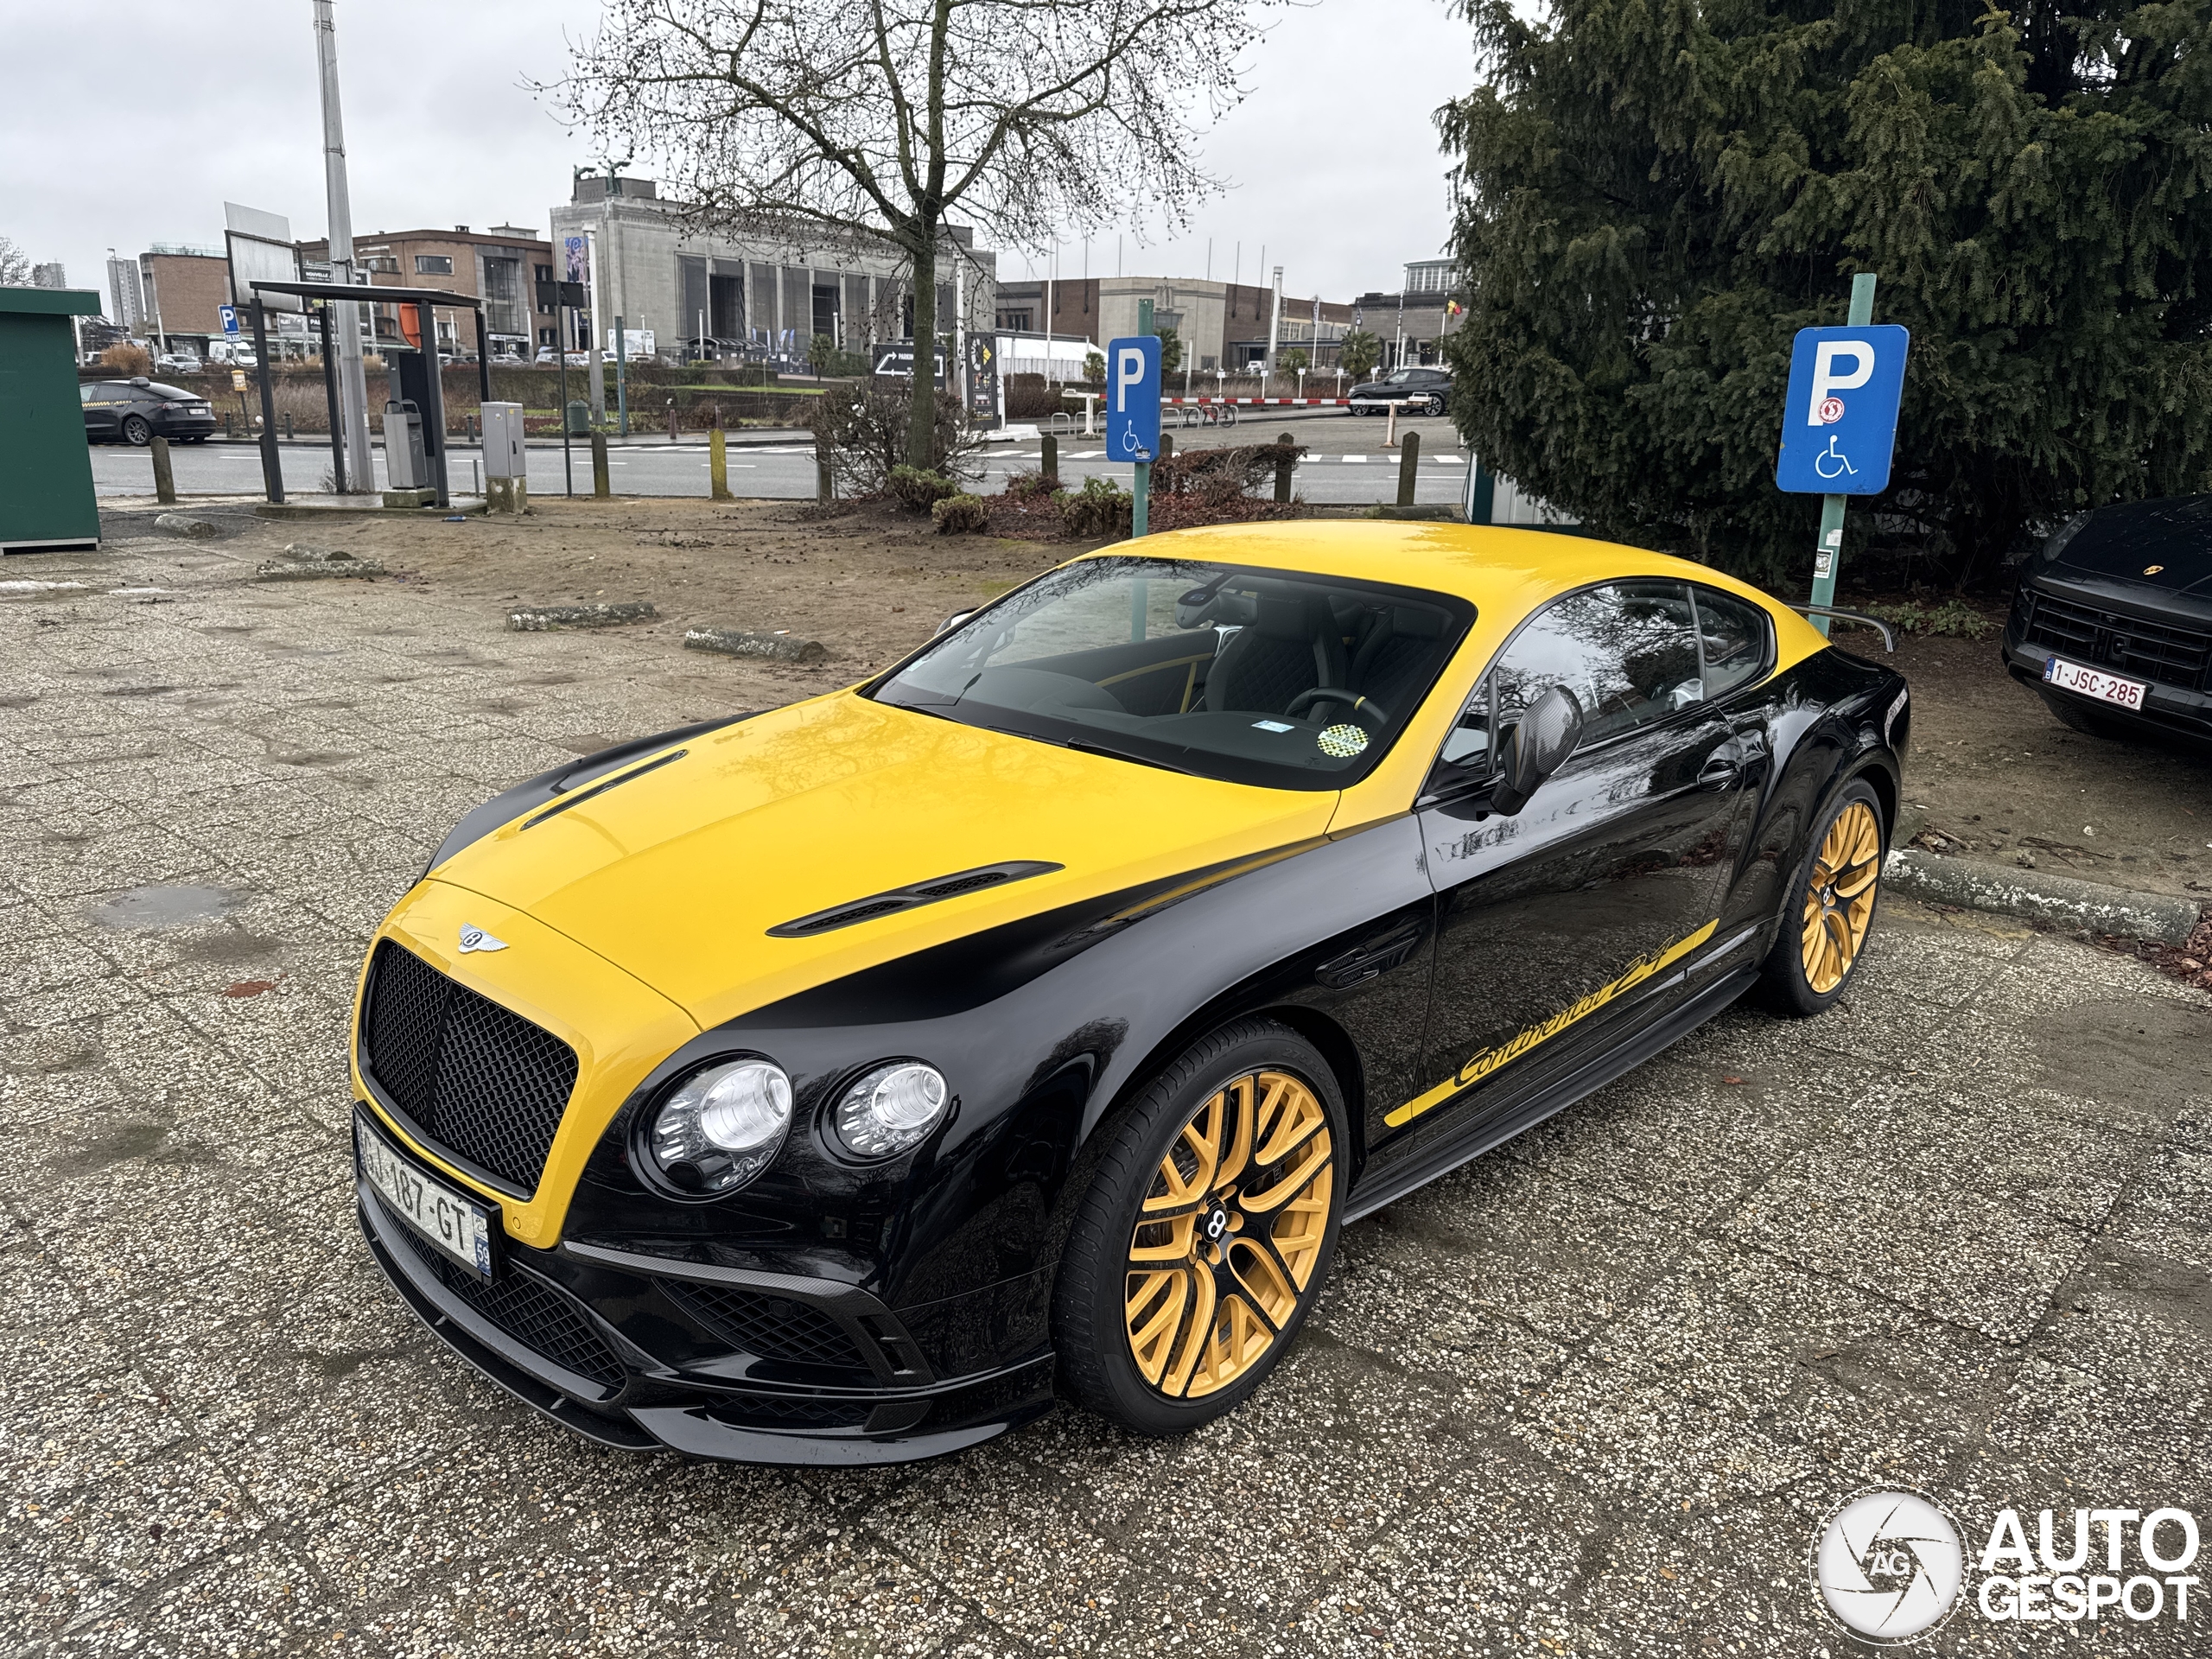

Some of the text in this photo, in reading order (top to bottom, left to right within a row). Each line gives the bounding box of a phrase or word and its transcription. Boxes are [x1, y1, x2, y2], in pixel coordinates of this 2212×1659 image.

[221, 309, 234, 328] P
[226, 334, 242, 343] TAXIS
[1117, 347, 1145, 412] P
[1808, 340, 1875, 427] P
[2044, 671, 2051, 679] B
[2056, 664, 2140, 704] 1-JSC-285
[1454, 933, 1675, 1088] Continental 24
[476, 1243, 490, 1264] 59
